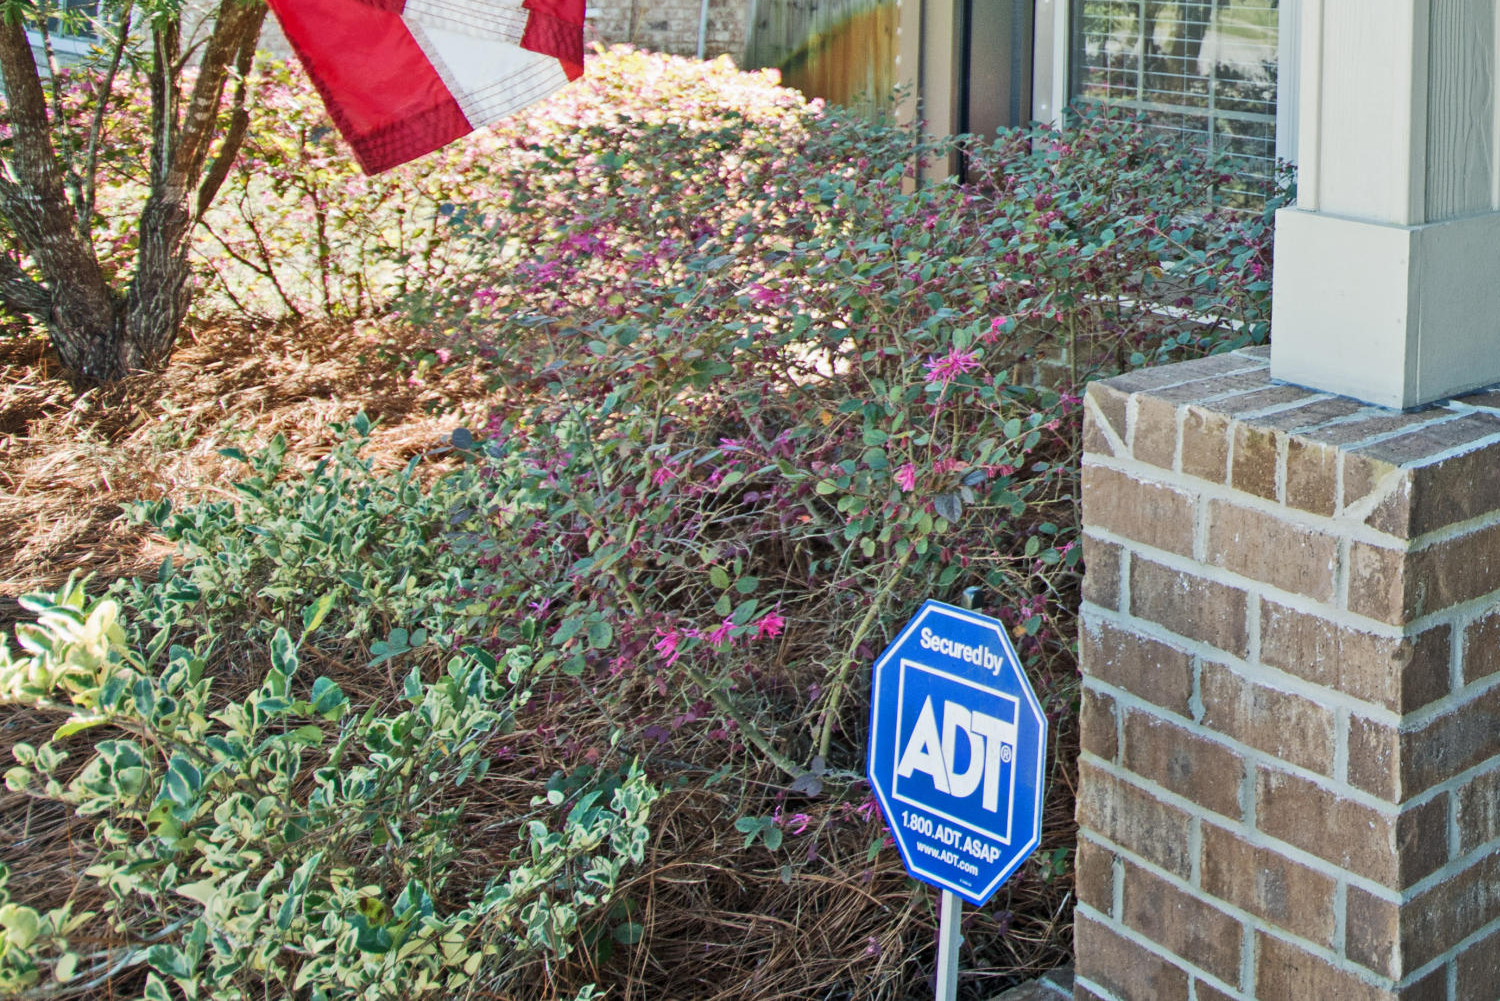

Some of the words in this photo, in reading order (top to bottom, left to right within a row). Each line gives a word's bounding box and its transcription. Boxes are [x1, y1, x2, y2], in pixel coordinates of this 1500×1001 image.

[920, 627, 984, 666] Secured
[984, 646, 1004, 676] by
[901, 810, 1000, 864] 1.800.ADT.ASAP
[916, 840, 979, 876] www.ADT.com
